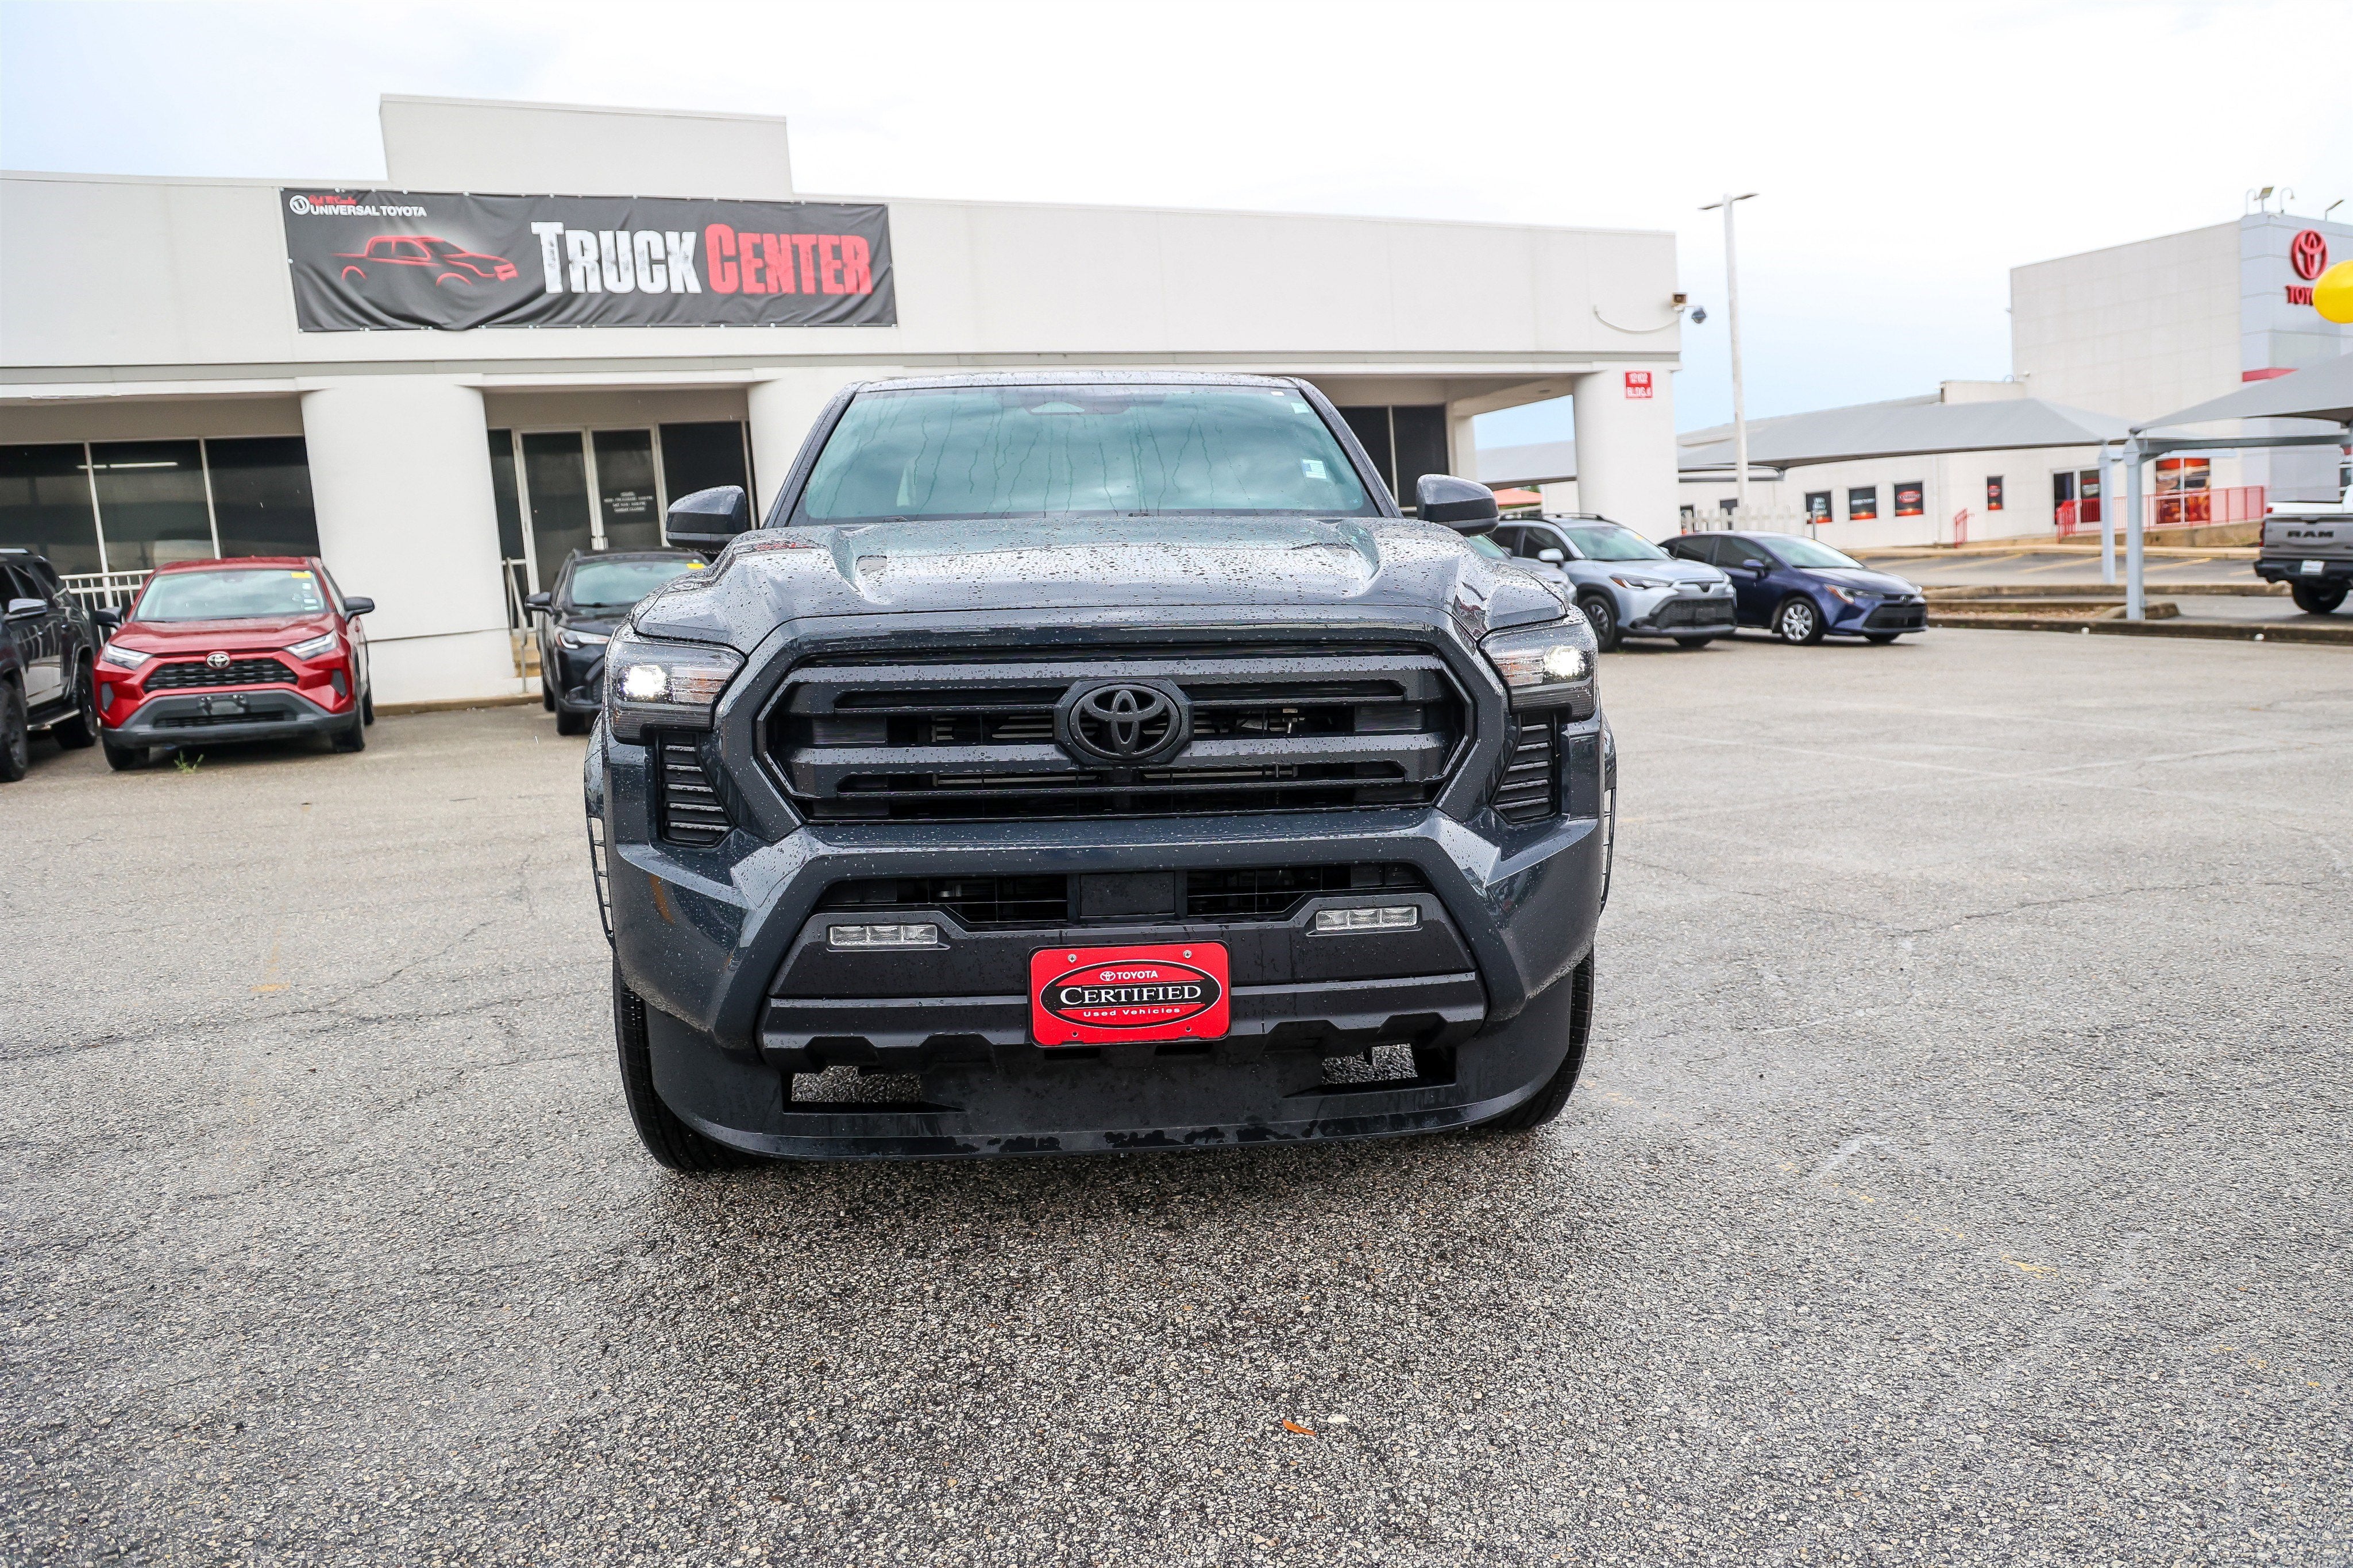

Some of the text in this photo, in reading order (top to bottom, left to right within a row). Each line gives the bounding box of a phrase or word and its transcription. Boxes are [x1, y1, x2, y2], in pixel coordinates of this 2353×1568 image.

[310, 205, 380, 216] UNIVERSAL
[380, 205, 427, 217] TOYOTA
[531, 221, 873, 295] TRUCK CENTER
[1116, 970, 1159, 980] TOYOTA
[1060, 986, 1202, 1005] CERTIFIED
